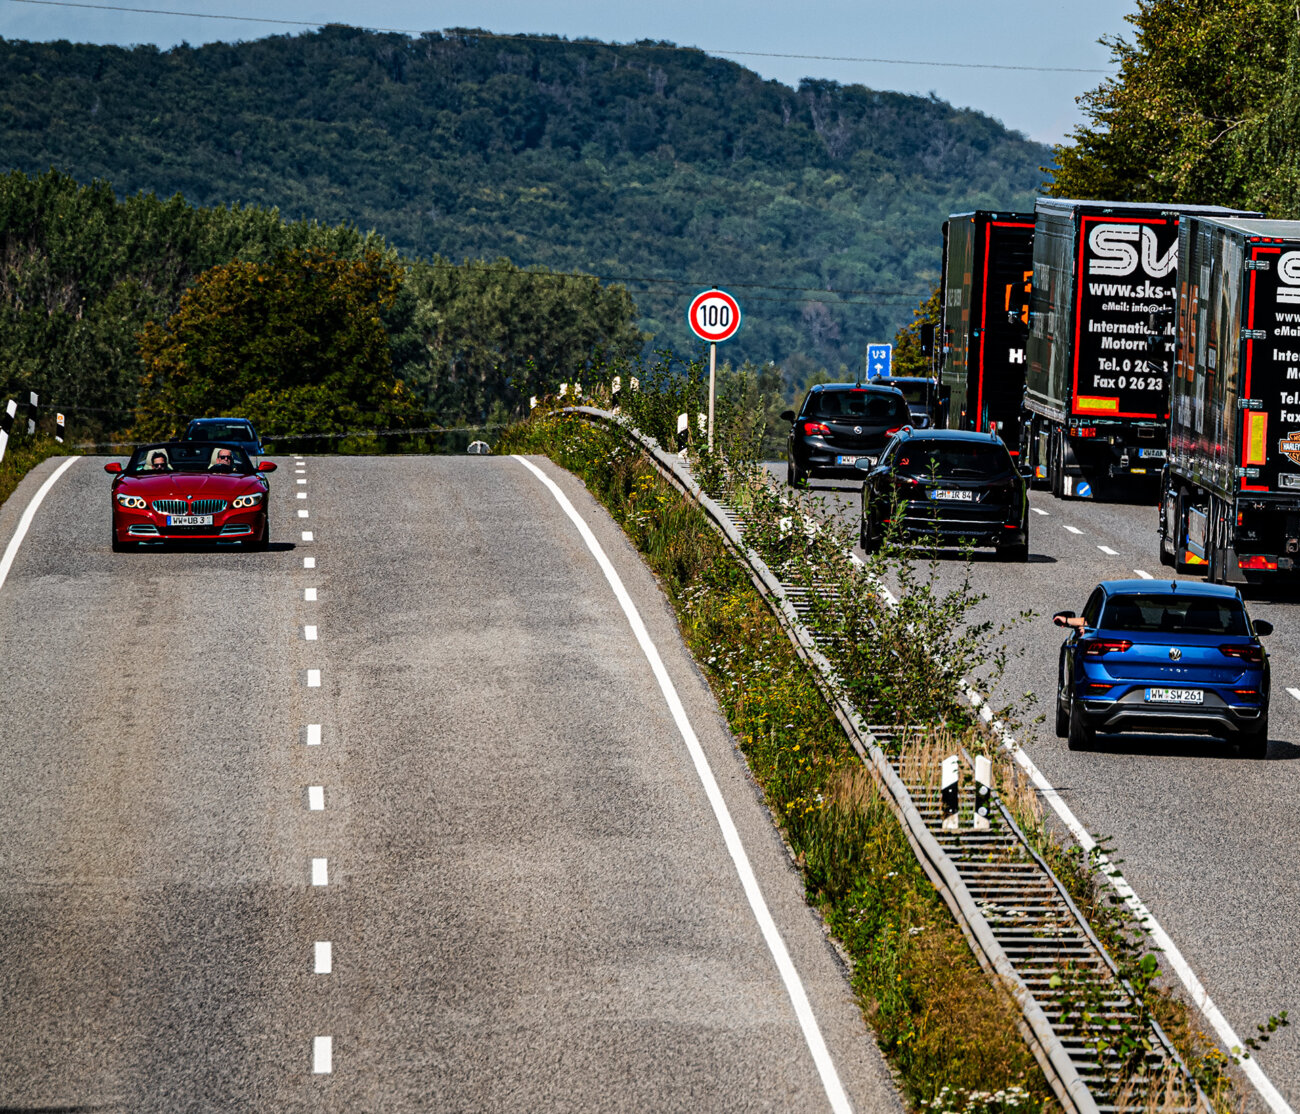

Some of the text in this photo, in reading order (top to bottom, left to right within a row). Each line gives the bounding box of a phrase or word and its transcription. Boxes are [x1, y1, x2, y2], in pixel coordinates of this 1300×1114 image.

[1101, 302, 1130, 312] eMail:
[700, 305, 729, 327] 100
[1098, 357, 1120, 371] Tel.
[1122, 358, 1131, 372] 0
[1093, 374, 1163, 391] Fax 0 26 23
[1151, 689, 1202, 701] WW SW 261
